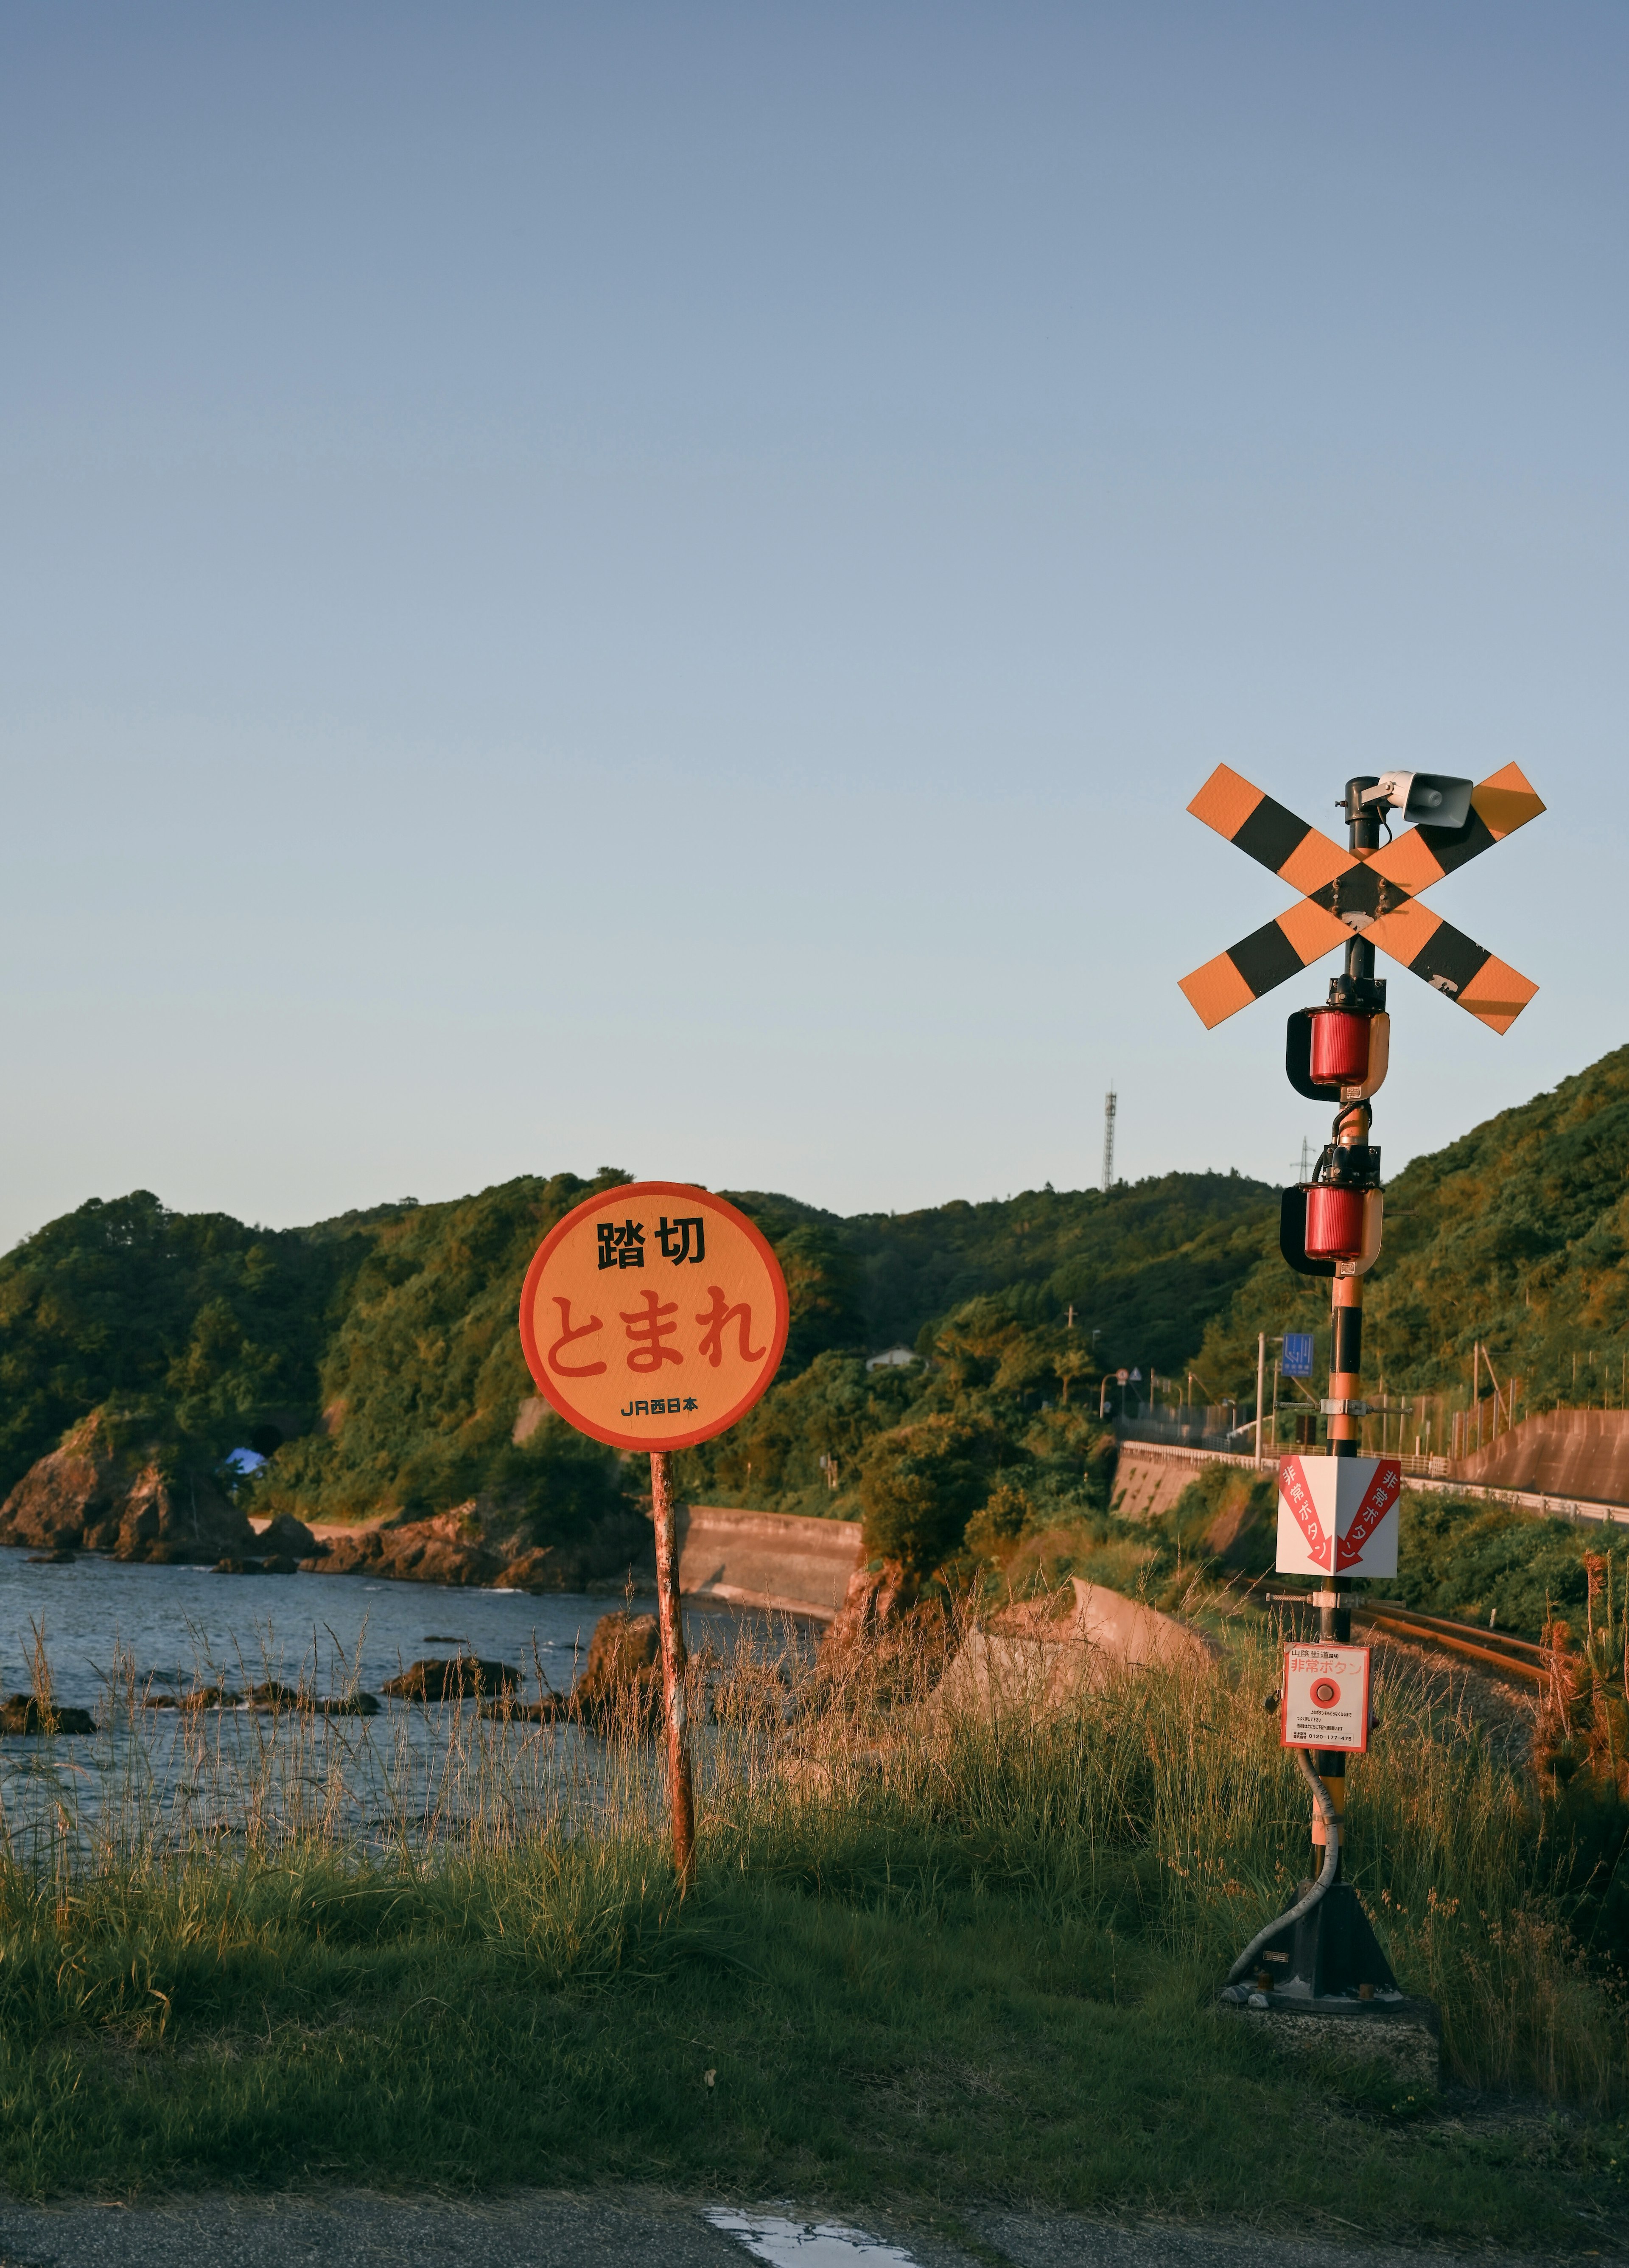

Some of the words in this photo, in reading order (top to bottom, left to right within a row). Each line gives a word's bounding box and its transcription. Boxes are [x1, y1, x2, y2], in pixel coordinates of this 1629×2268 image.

[597, 1217, 705, 1270] 踏切
[548, 1286, 767, 1377] とまれ
[621, 1397, 698, 1416] JR西日本
[1282, 1465, 1326, 1559] 非常ボタン
[1341, 1470, 1398, 1557] 非常ボタン
[1291, 1650, 1339, 1659] 山陰街道踏切
[1291, 1658, 1362, 1675] 非常ボタン
